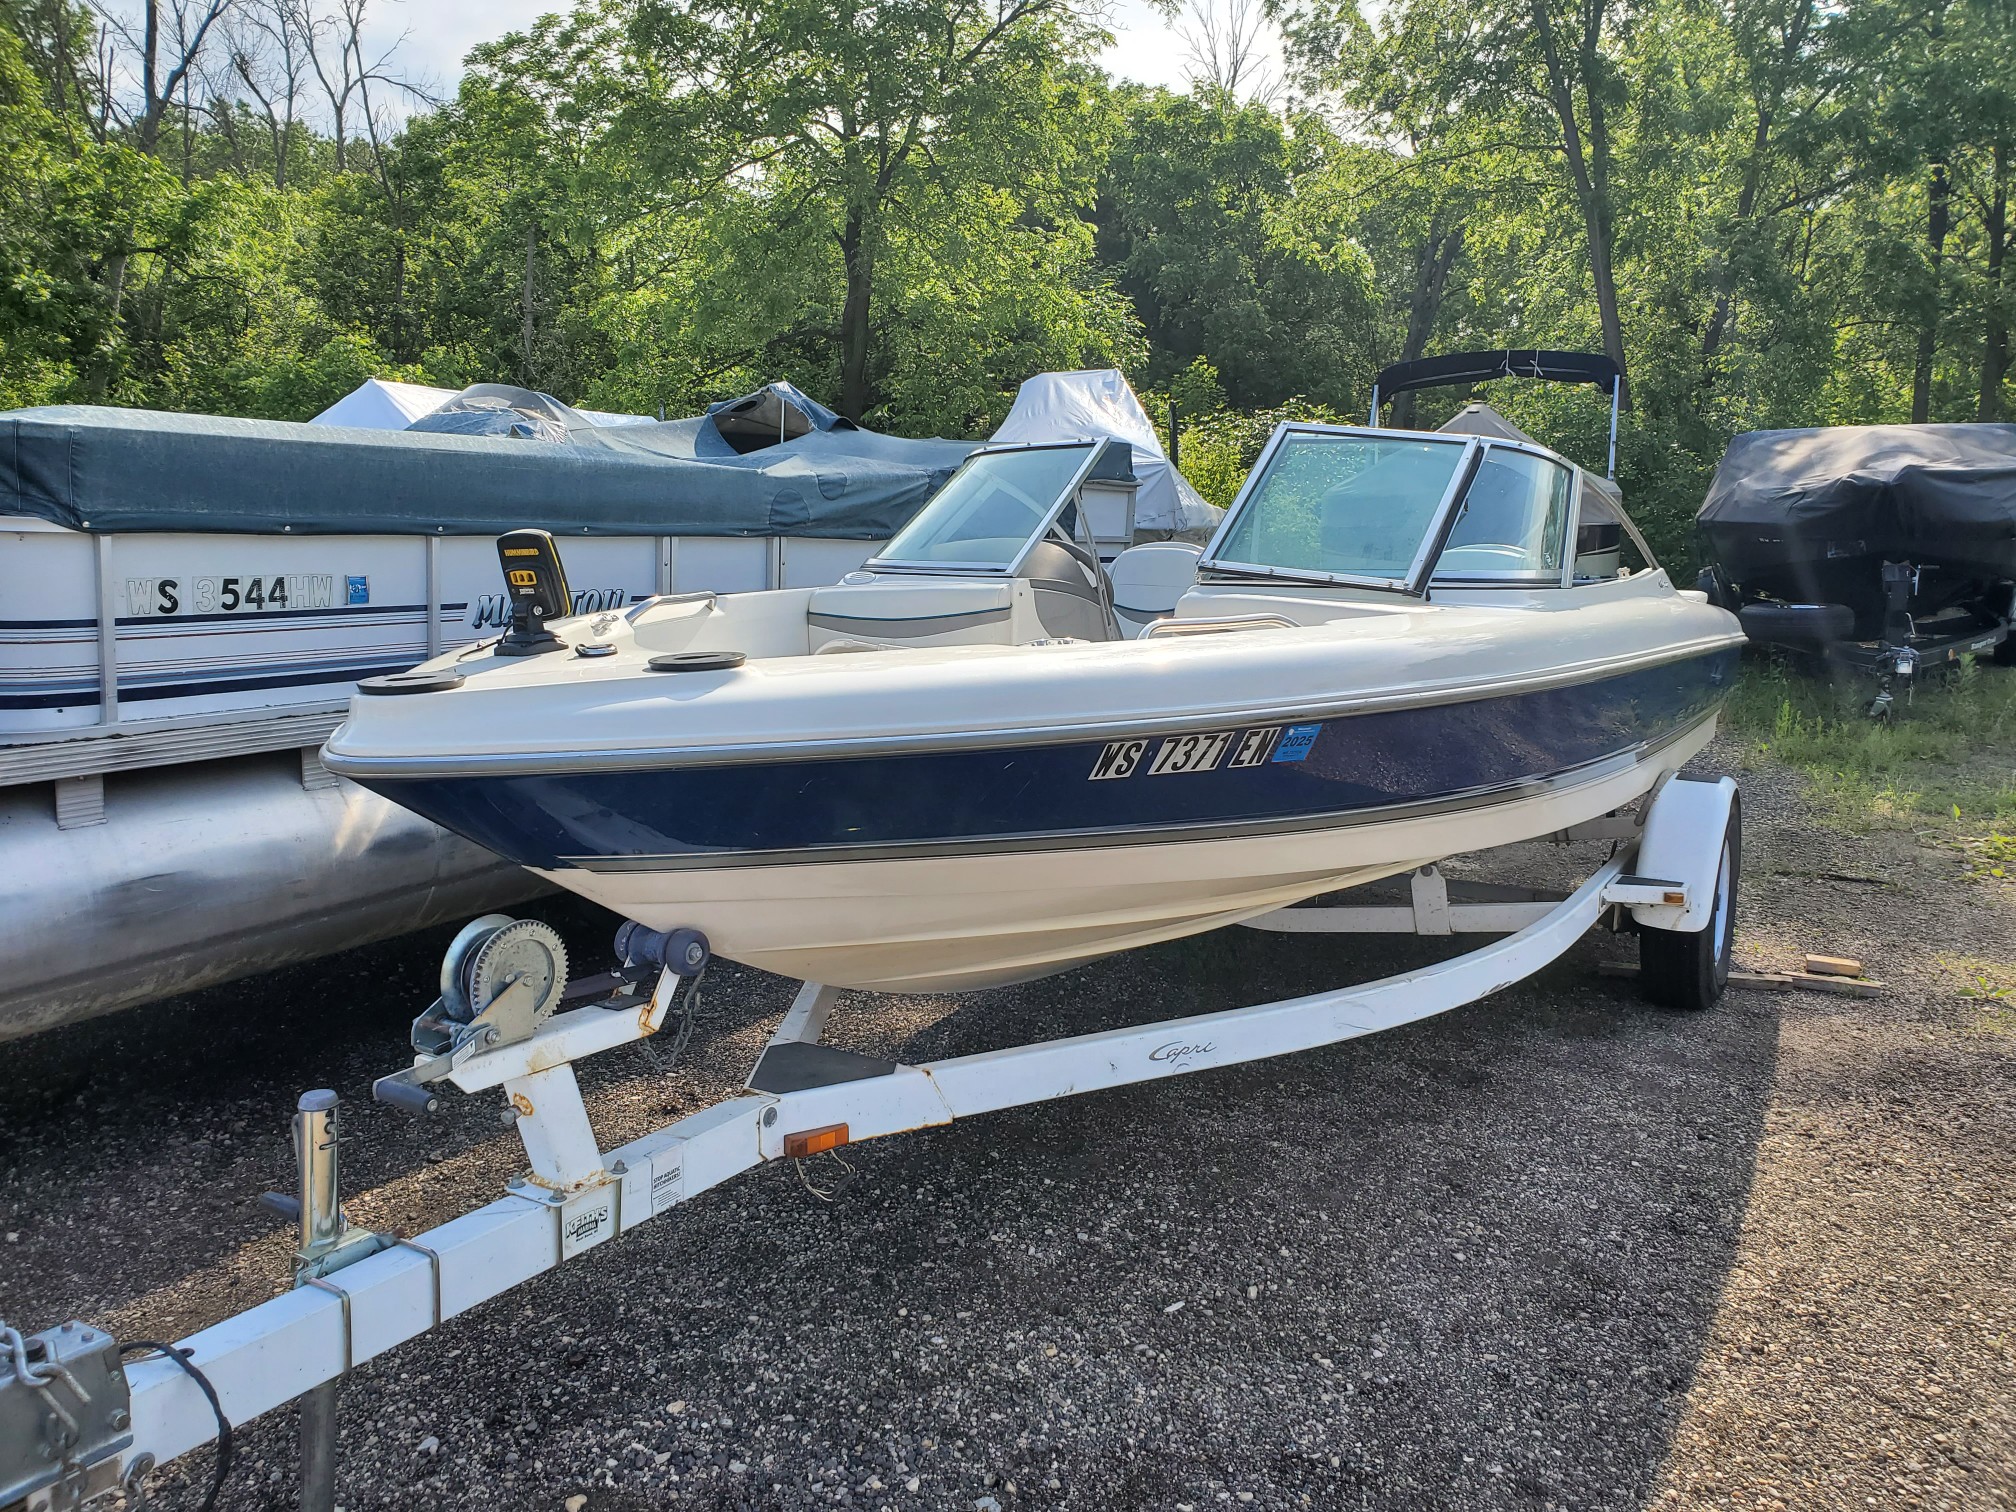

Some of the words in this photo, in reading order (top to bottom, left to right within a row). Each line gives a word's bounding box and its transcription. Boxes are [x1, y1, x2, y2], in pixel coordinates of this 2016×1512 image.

[128, 578, 179, 616] WS
[1093, 741, 1143, 778] WS
[1154, 731, 1234, 773] 7371
[1230, 728, 1278, 767] EN
[1281, 735, 1314, 748] 2025
[1148, 1040, 1217, 1064] Capri
[653, 1174, 664, 1184] STOP
[664, 1165, 681, 1179] AQUATIC
[565, 1206, 608, 1239] KEITH'S
